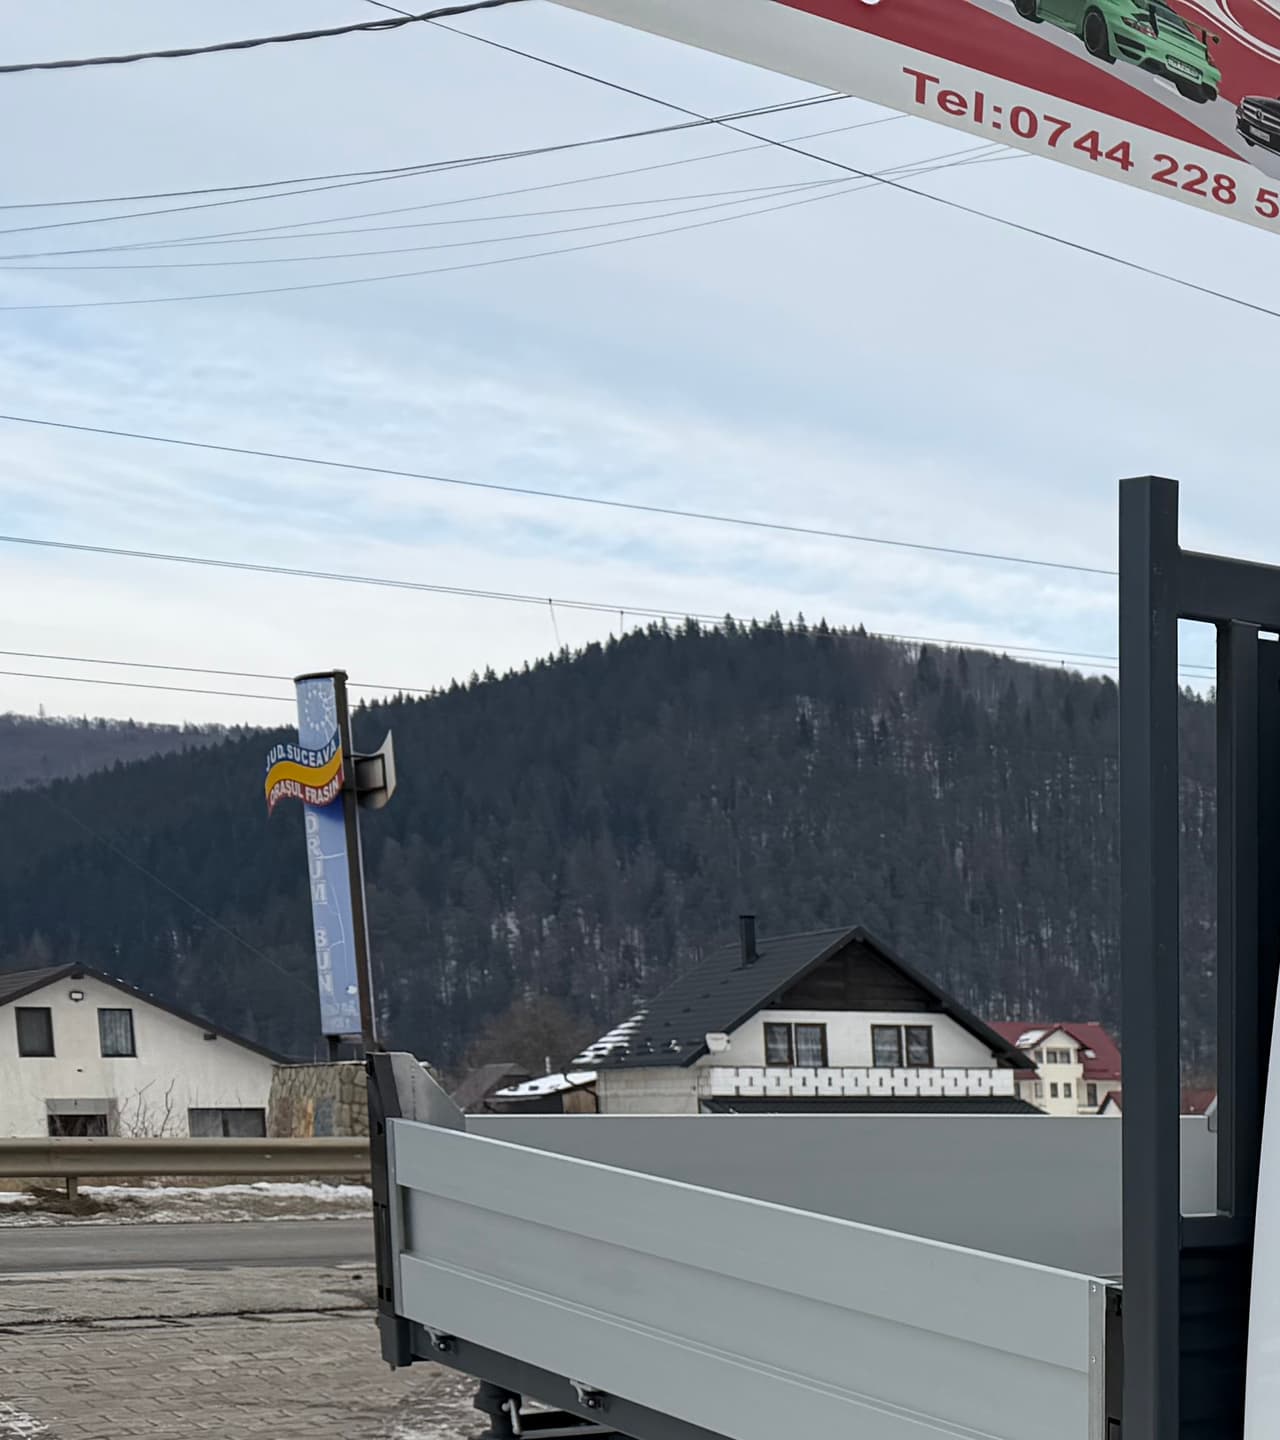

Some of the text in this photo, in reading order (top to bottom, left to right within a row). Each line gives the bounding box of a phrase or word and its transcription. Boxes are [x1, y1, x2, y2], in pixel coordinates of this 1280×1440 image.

[903, 67, 1134, 172] Tel:0744
[1151, 153, 1237, 204] 228
[286, 739, 337, 767] SUCEAVA
[304, 775, 340, 805] FRASIN
[305, 811, 334, 996] DRUM BUN
